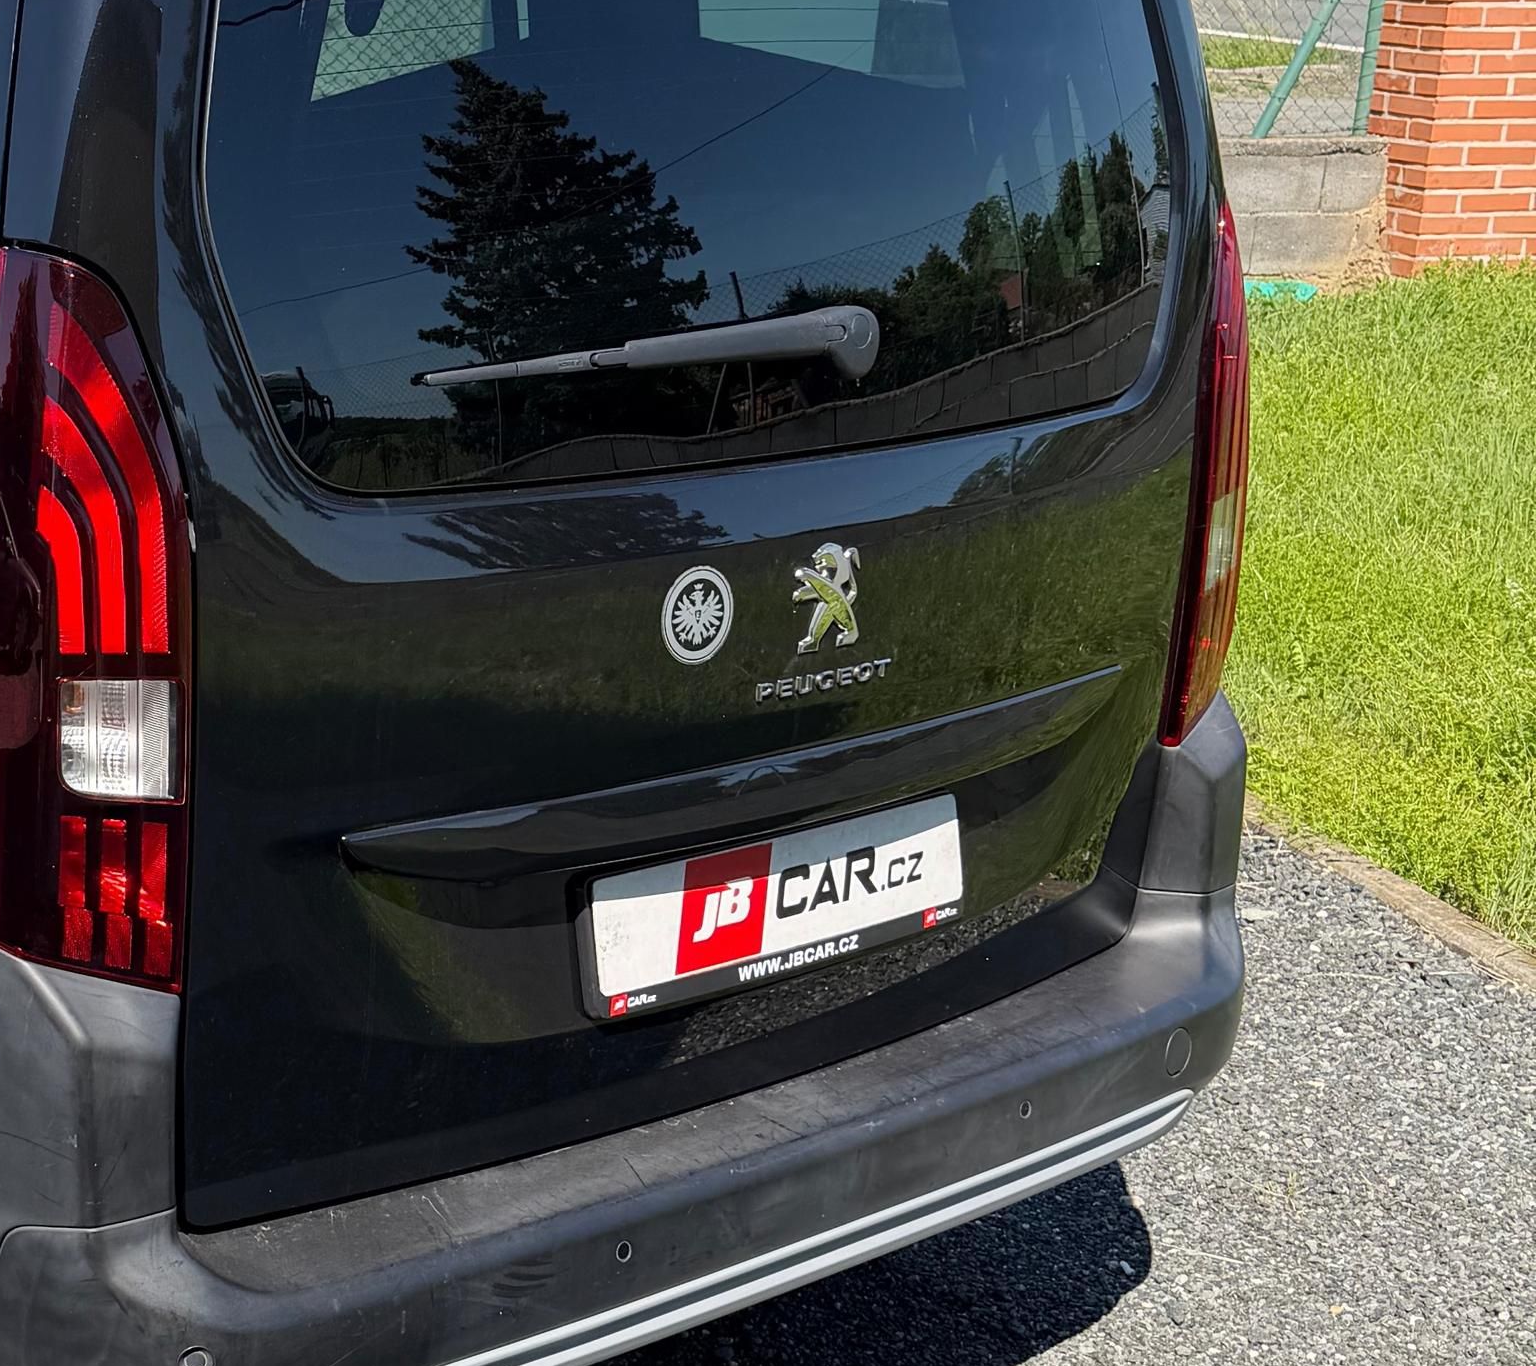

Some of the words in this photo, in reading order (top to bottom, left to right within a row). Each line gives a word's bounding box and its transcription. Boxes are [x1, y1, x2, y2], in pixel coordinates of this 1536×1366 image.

[754, 658, 892, 703] PEUGEOT
[692, 876, 754, 944] JB
[737, 934, 860, 983] WWW.JBCAR.CZ
